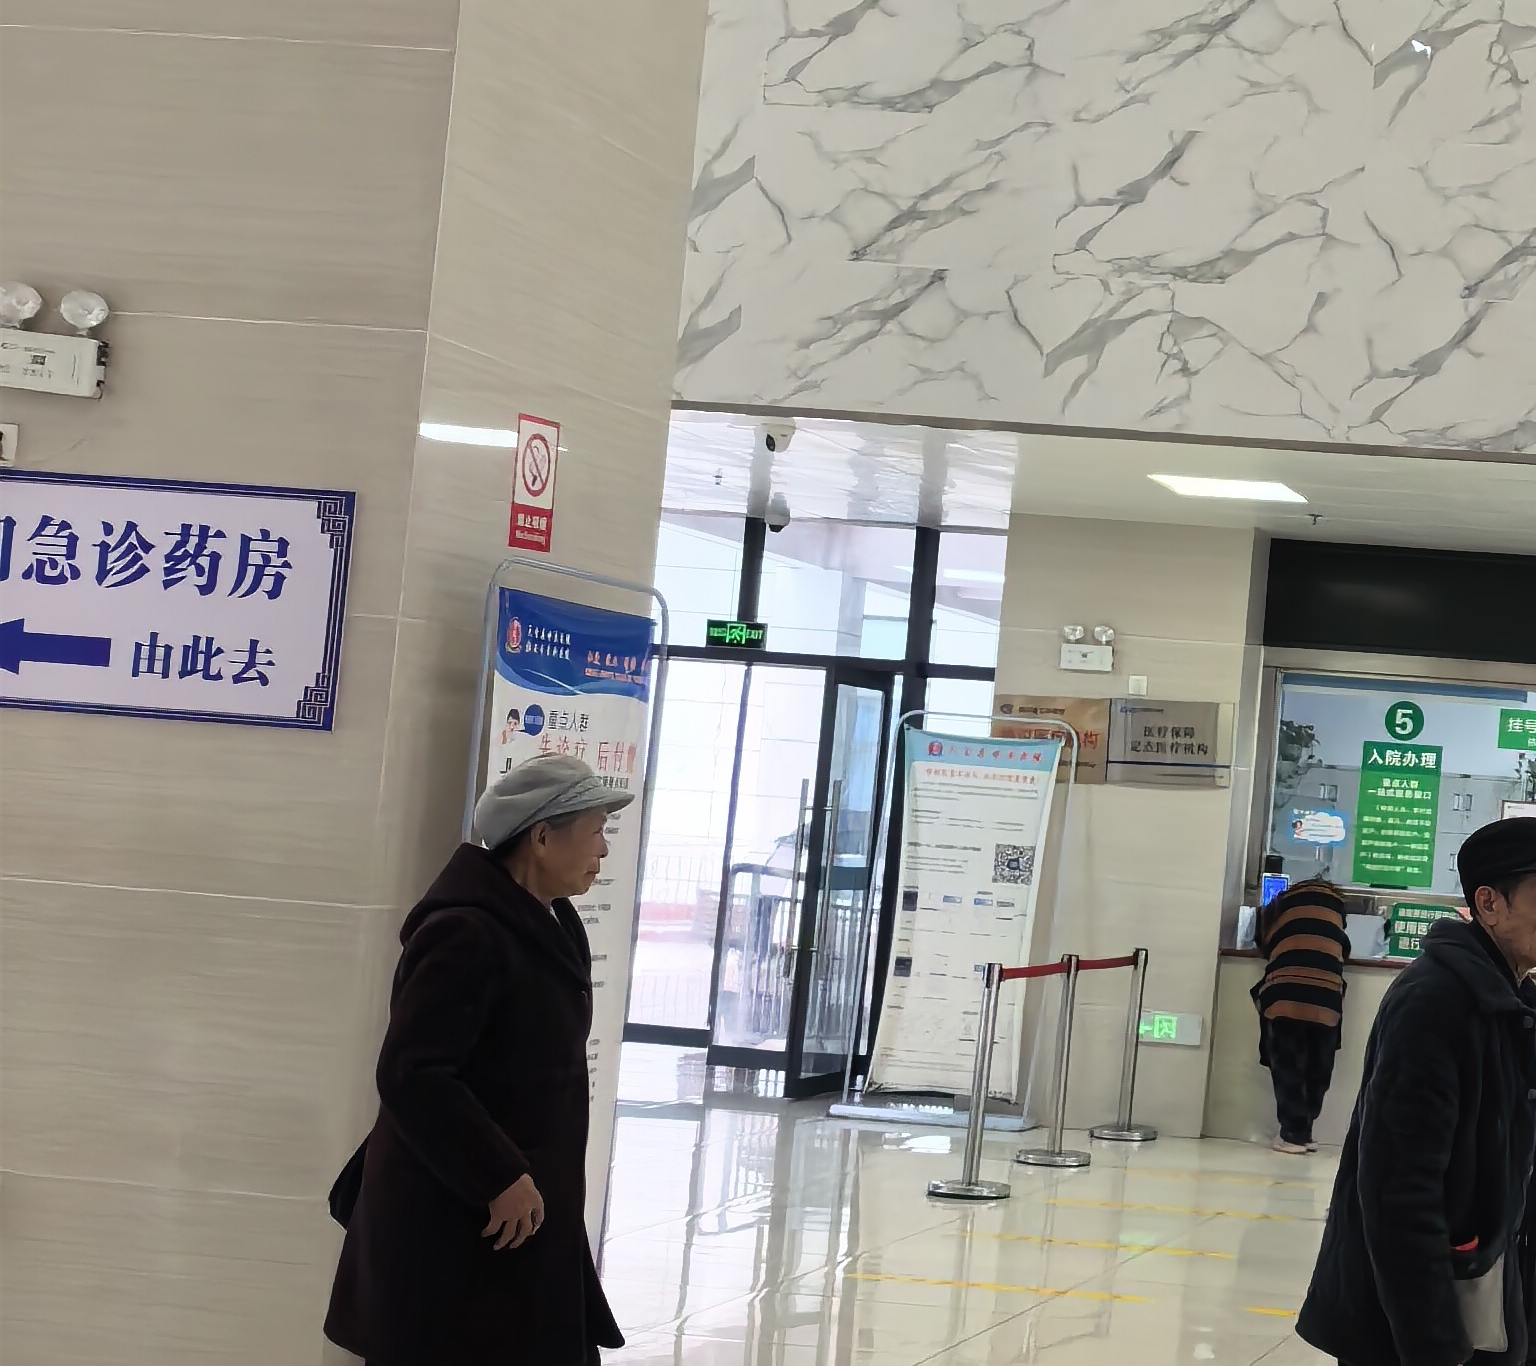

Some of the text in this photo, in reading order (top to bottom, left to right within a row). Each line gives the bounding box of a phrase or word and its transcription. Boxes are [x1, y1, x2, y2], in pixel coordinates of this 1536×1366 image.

[131, 632, 276, 686] 由此去
[1394, 709, 1414, 735] 5
[1368, 748, 1437, 769] 入院办理
